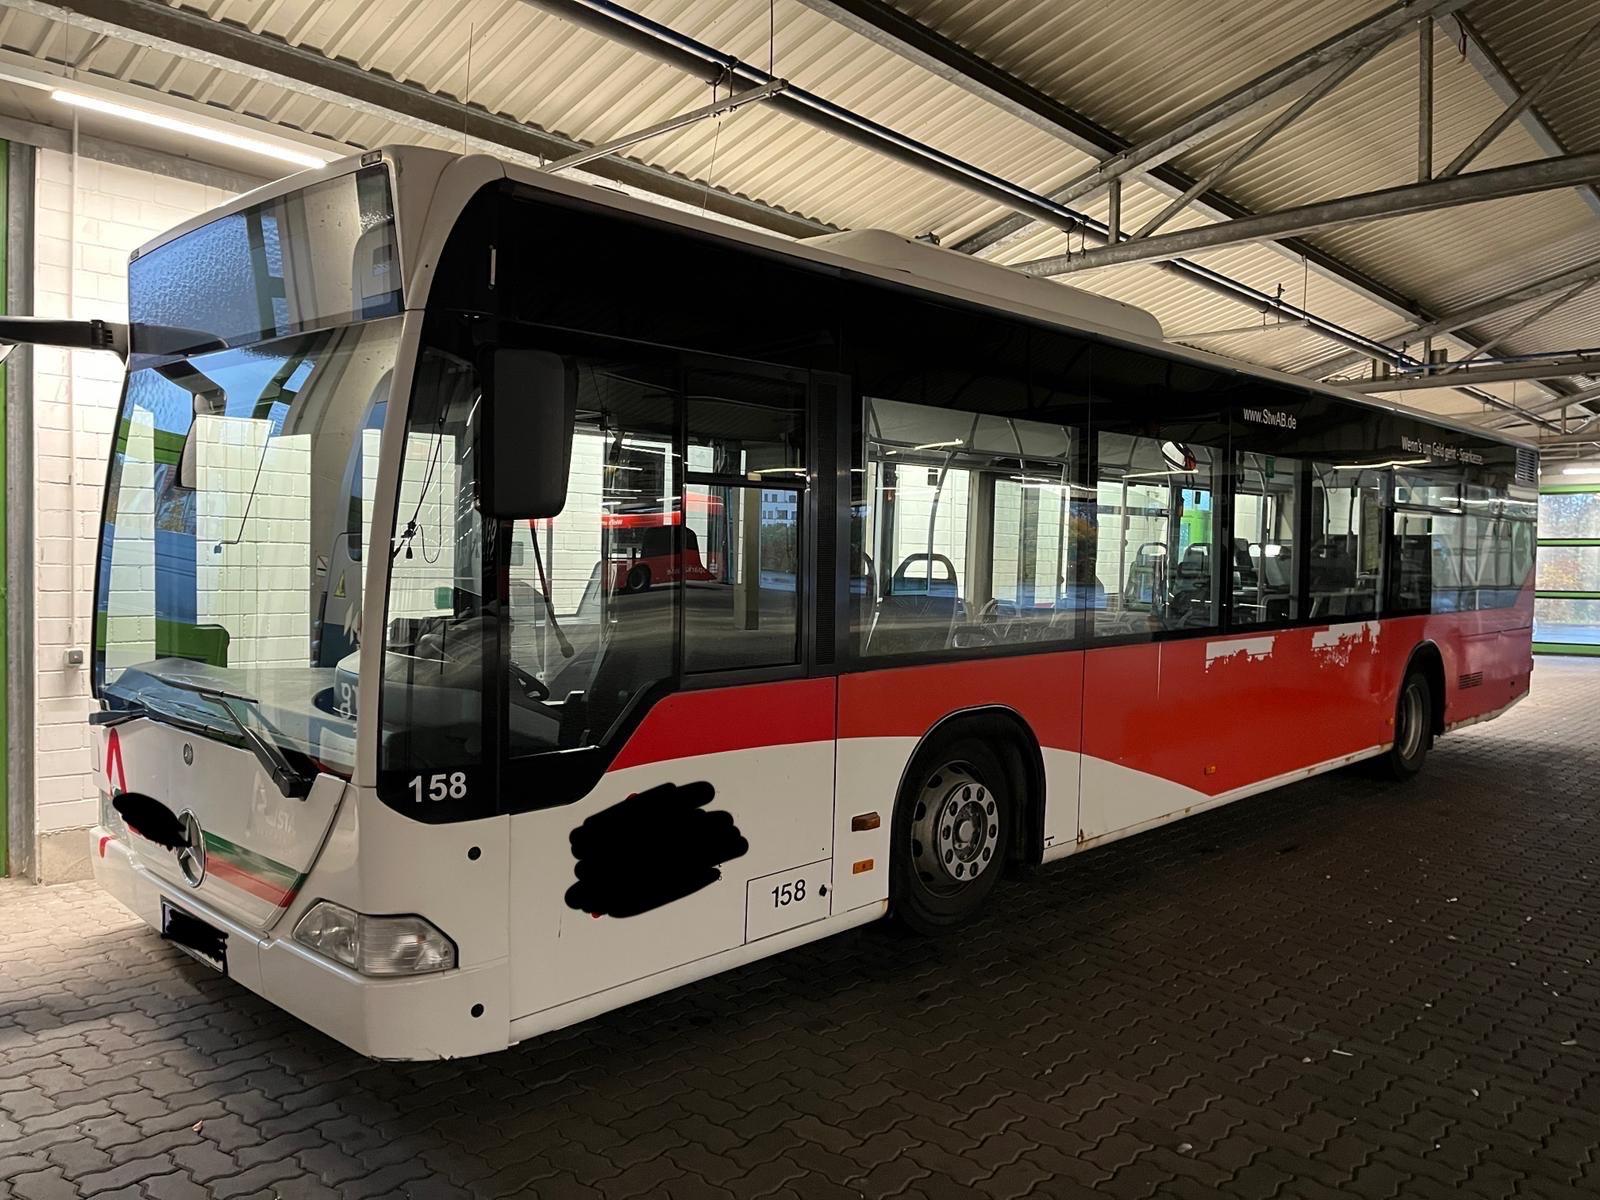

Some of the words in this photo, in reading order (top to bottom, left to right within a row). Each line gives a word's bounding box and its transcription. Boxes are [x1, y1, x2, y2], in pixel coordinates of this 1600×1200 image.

[1242, 407, 1297, 430] www.StwAB.de
[1401, 435, 1422, 453] Wenn's
[1432, 441, 1444, 457] Geld
[408, 771, 468, 803] 158
[771, 879, 807, 909] 158
